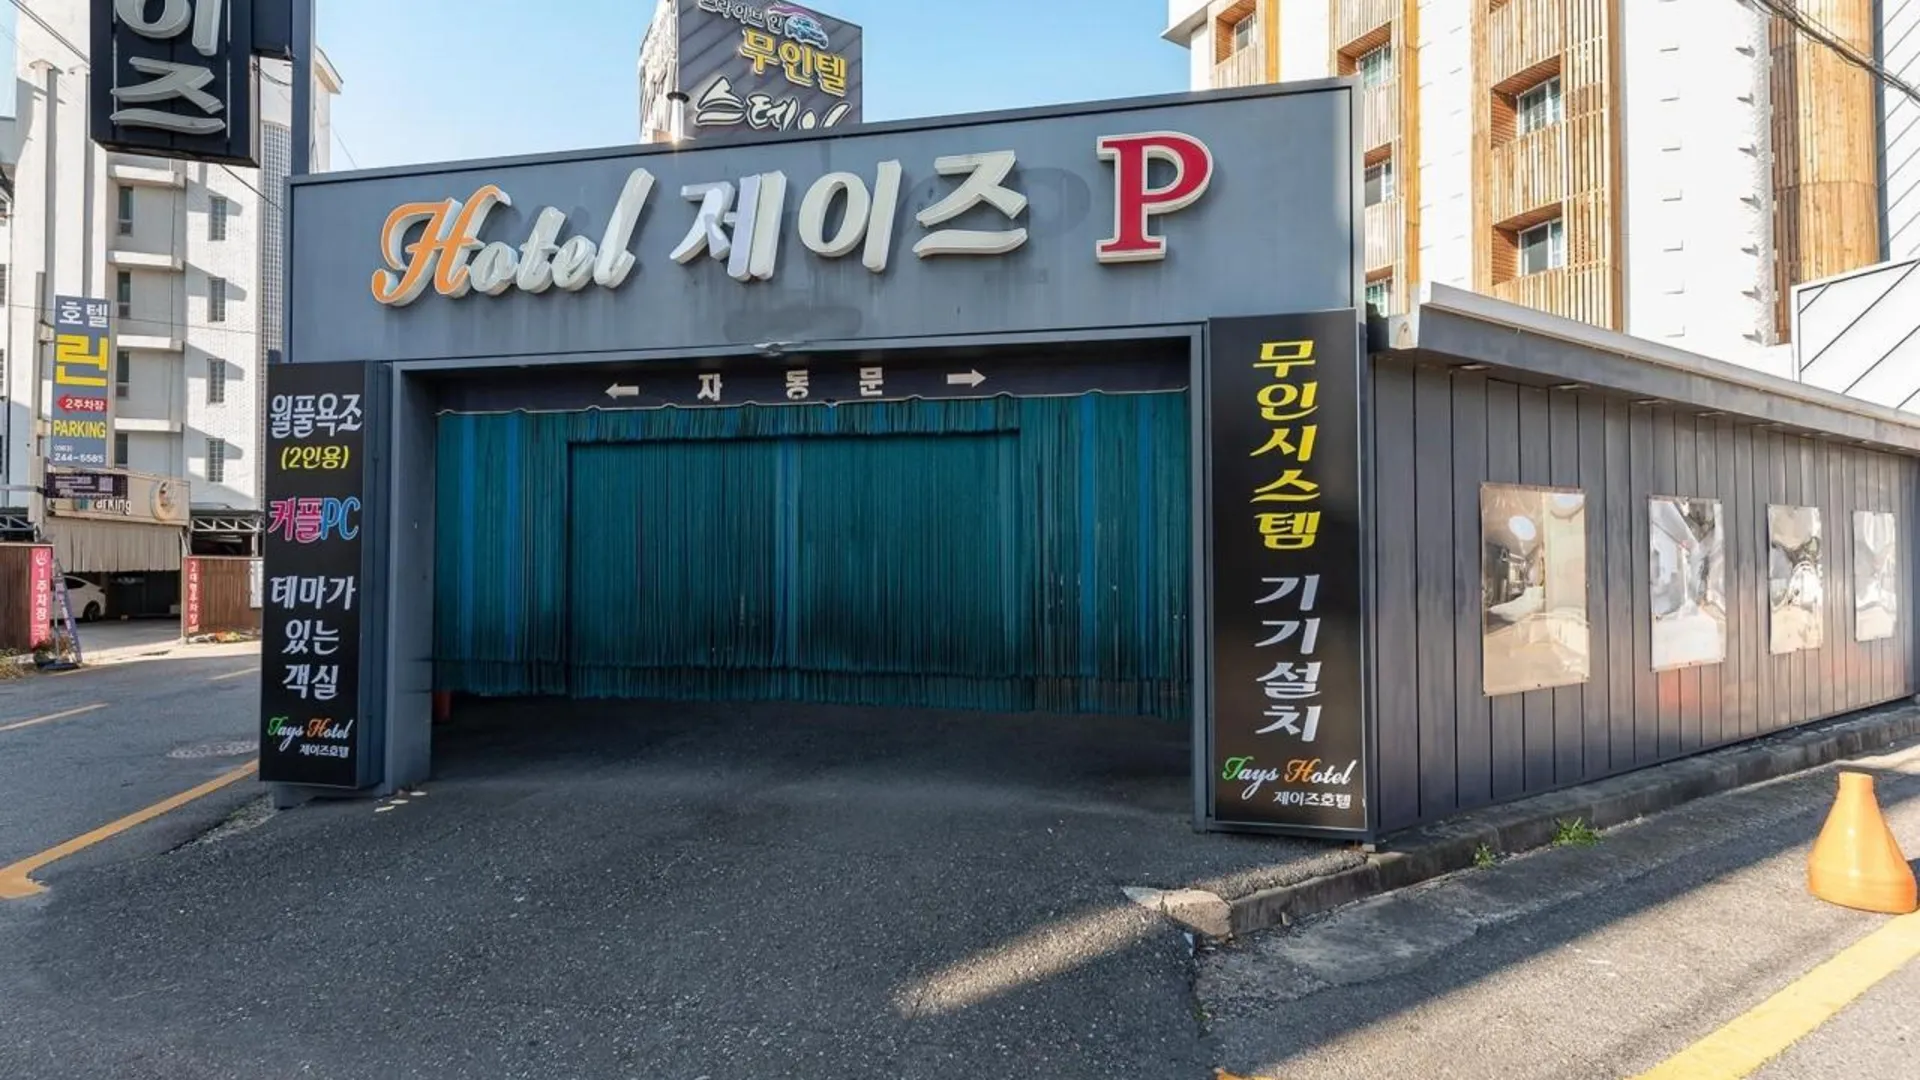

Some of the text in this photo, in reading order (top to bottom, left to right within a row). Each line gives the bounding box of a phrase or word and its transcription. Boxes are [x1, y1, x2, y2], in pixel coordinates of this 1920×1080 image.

[740, 28, 848, 97] 무인텔
[371, 131, 1215, 308] Hotel 제이즈 P
[59, 301, 109, 328] 호텔
[65, 398, 104, 411] 2주차장
[270, 393, 362, 439] 월풀욕조
[53, 419, 106, 439] PARKING
[1249, 340, 1321, 550] 무인시스템
[280, 445, 349, 470] (2인용)
[267, 496, 361, 543] 커플PC
[270, 575, 356, 611] 테마가
[282, 619, 340, 656] 있는
[1254, 573, 1322, 743] 기기설치
[282, 663, 340, 701] 객실
[307, 717, 354, 740] Hotel
[299, 743, 350, 759] 제이즈호텔
[1284, 757, 1357, 786] Hotel
[1273, 790, 1352, 810] 제이즈호텔
